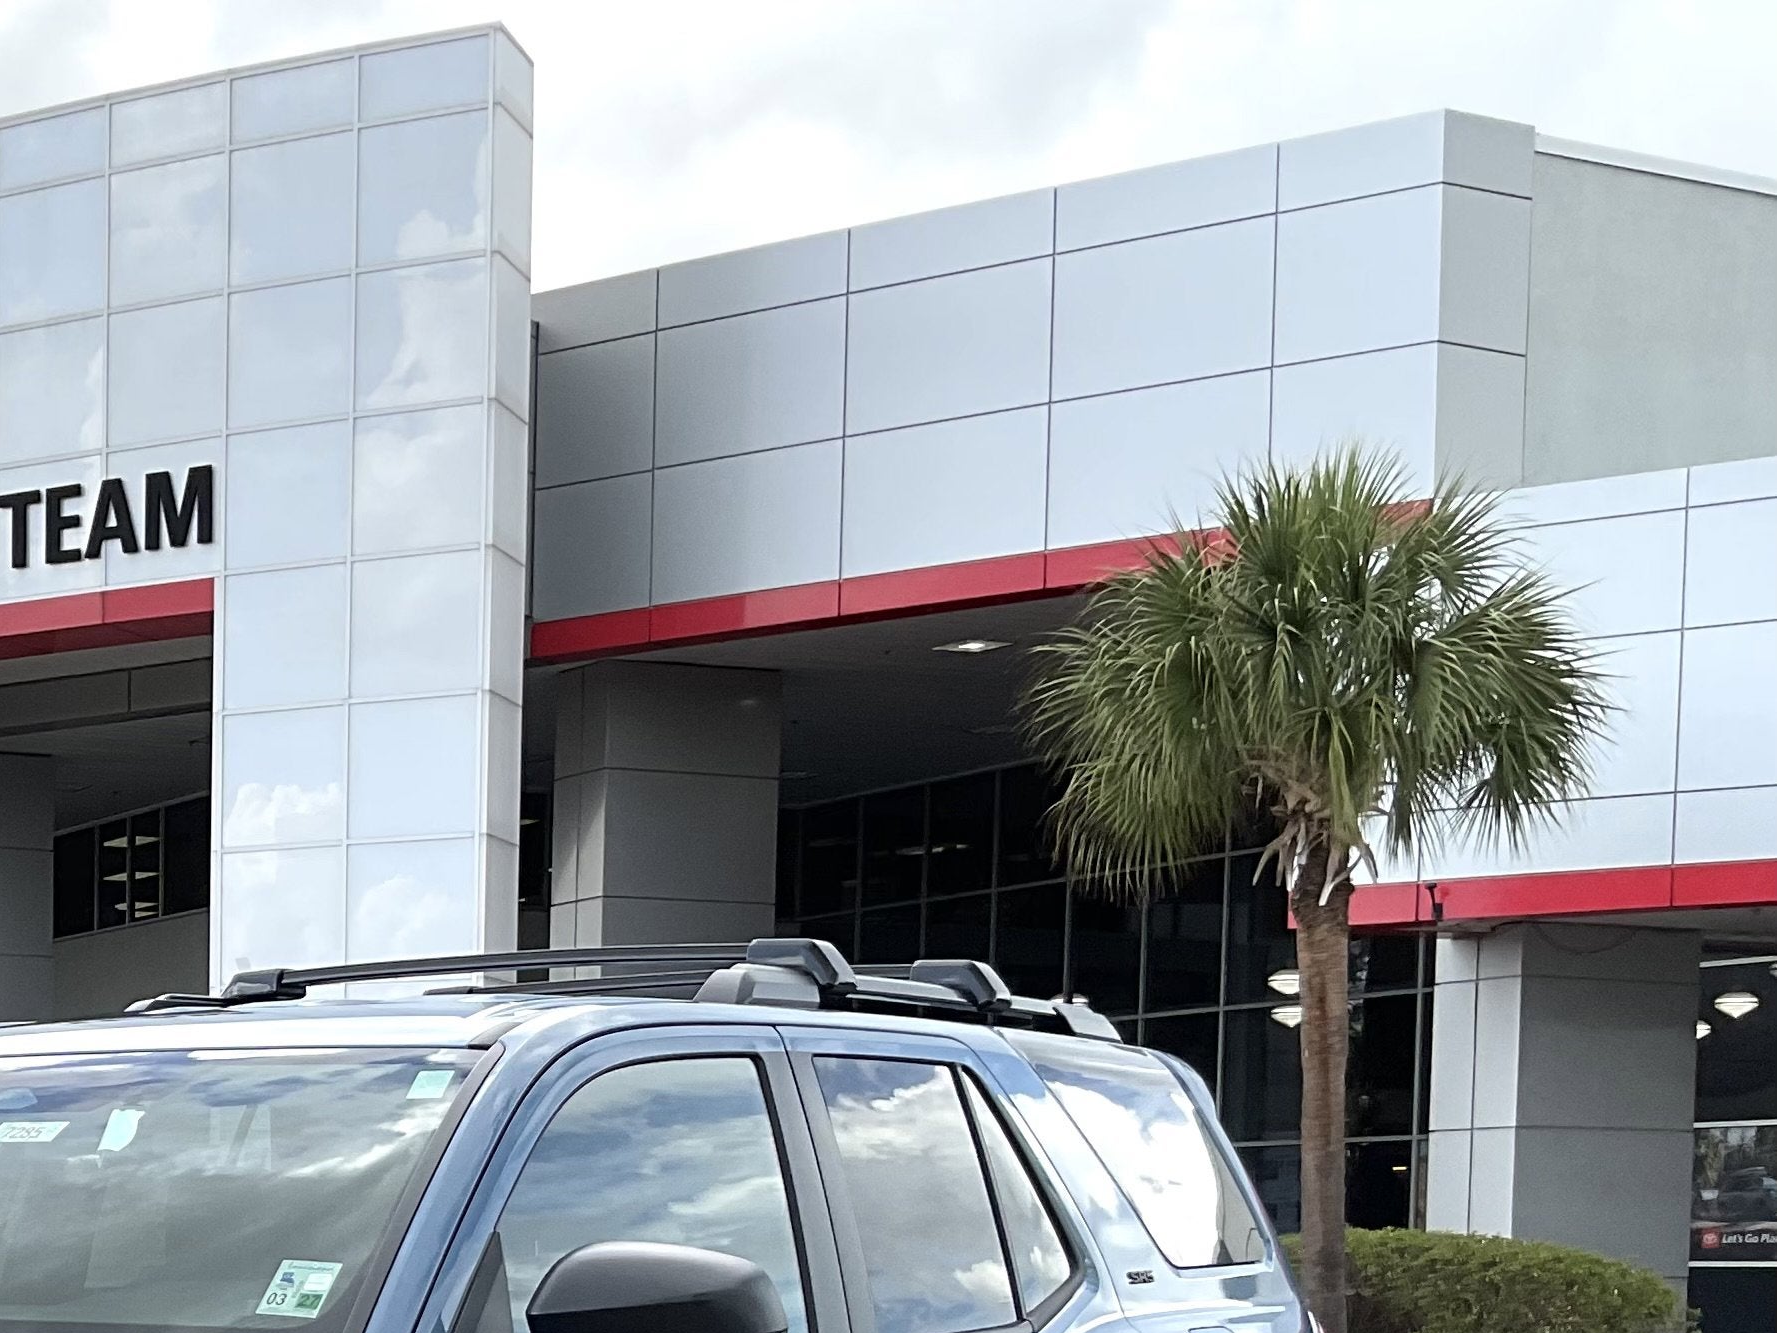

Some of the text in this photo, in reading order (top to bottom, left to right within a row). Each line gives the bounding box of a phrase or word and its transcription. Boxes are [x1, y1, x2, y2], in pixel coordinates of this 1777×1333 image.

[1721, 1233, 1743, 1244] Let's
[1745, 1233, 1760, 1244] Go
[266, 1292, 323, 1308] 03 27
